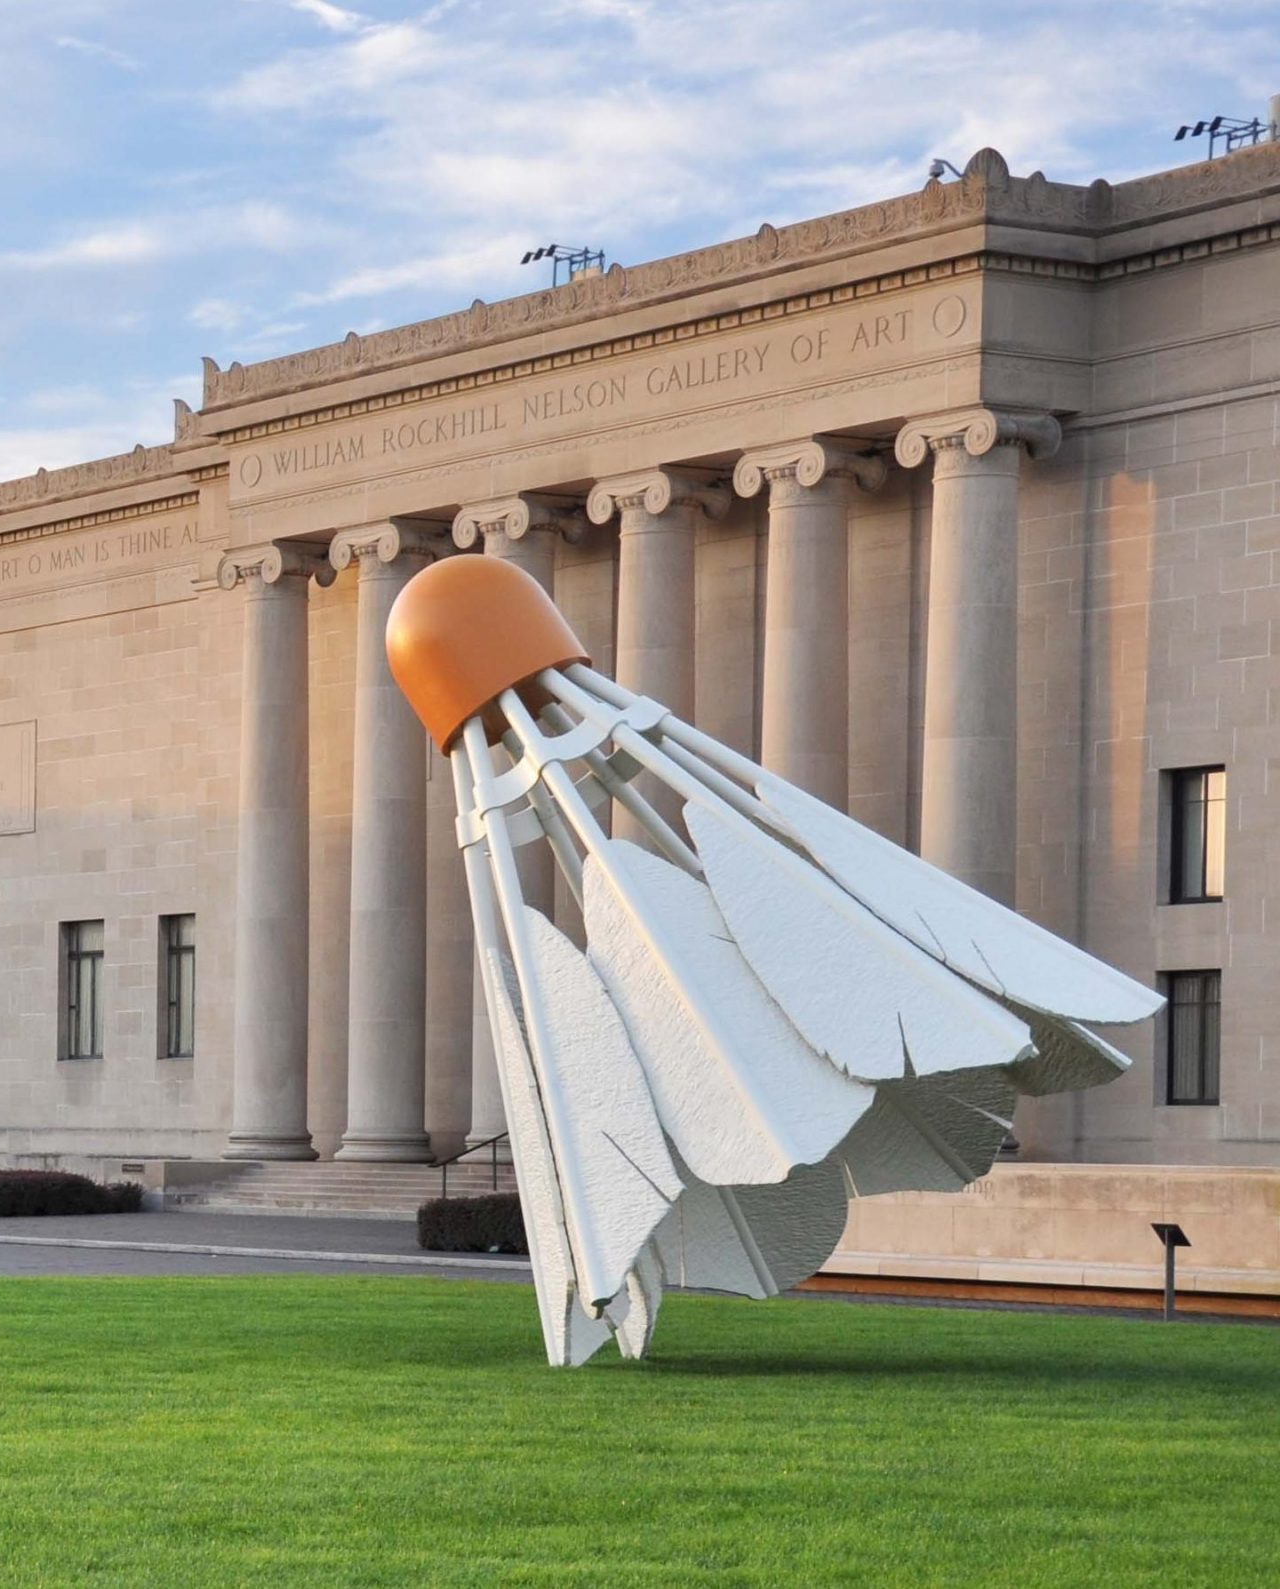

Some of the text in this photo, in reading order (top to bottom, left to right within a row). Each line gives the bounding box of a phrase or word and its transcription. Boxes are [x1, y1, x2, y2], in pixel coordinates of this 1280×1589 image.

[273, 310, 912, 476] WILLIAM ROCKHILL NELSON GALLERY OF ART
[28, 554, 42, 575] O
[49, 544, 86, 571] MAN
[95, 538, 110, 563] IS
[119, 526, 172, 558] THINE
